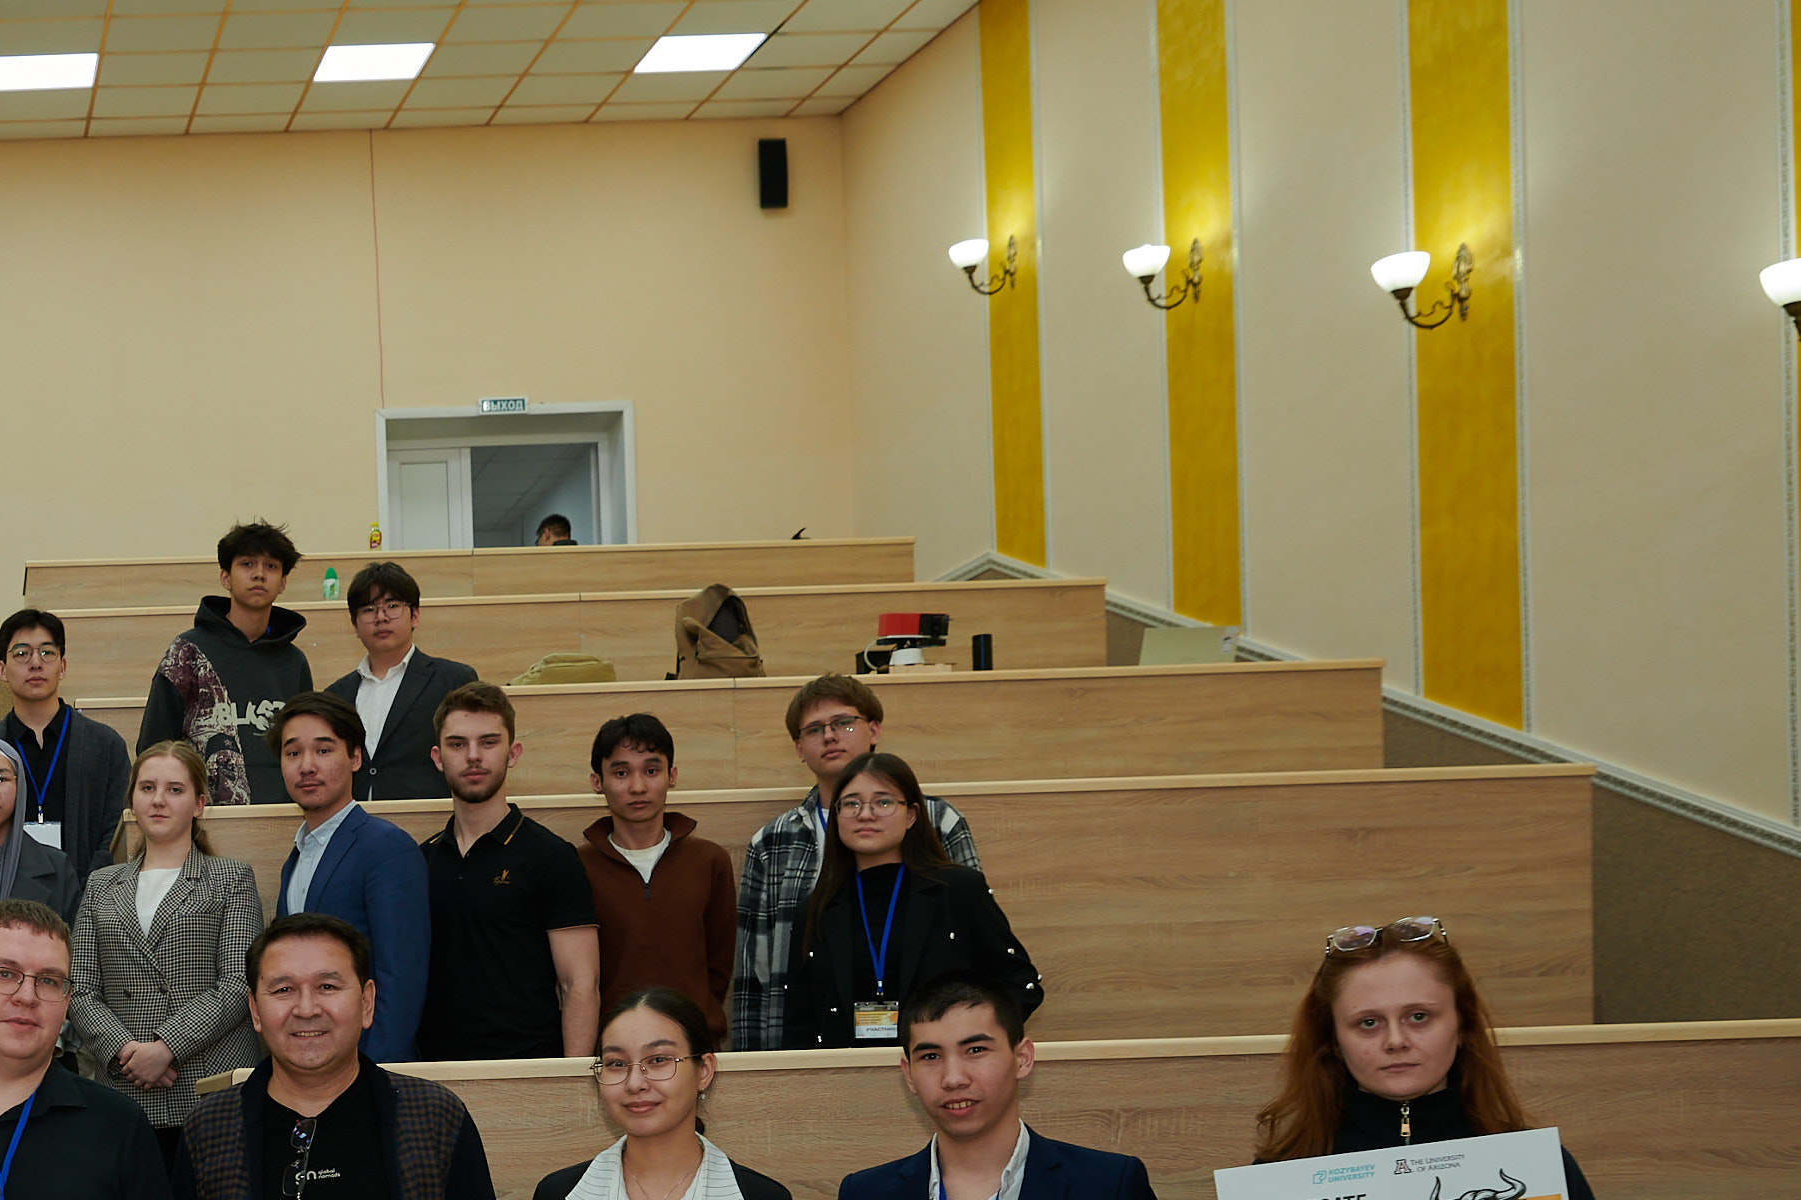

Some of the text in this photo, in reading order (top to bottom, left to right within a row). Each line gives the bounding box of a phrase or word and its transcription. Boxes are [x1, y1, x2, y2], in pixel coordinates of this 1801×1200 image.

[483, 400, 524, 411] ВЫХОД
[1410, 1152, 1466, 1166] THE UNIVERSITY
[1426, 1160, 1461, 1172] ARIZONA
[1328, 1170, 1375, 1183] UNIVERSITY
